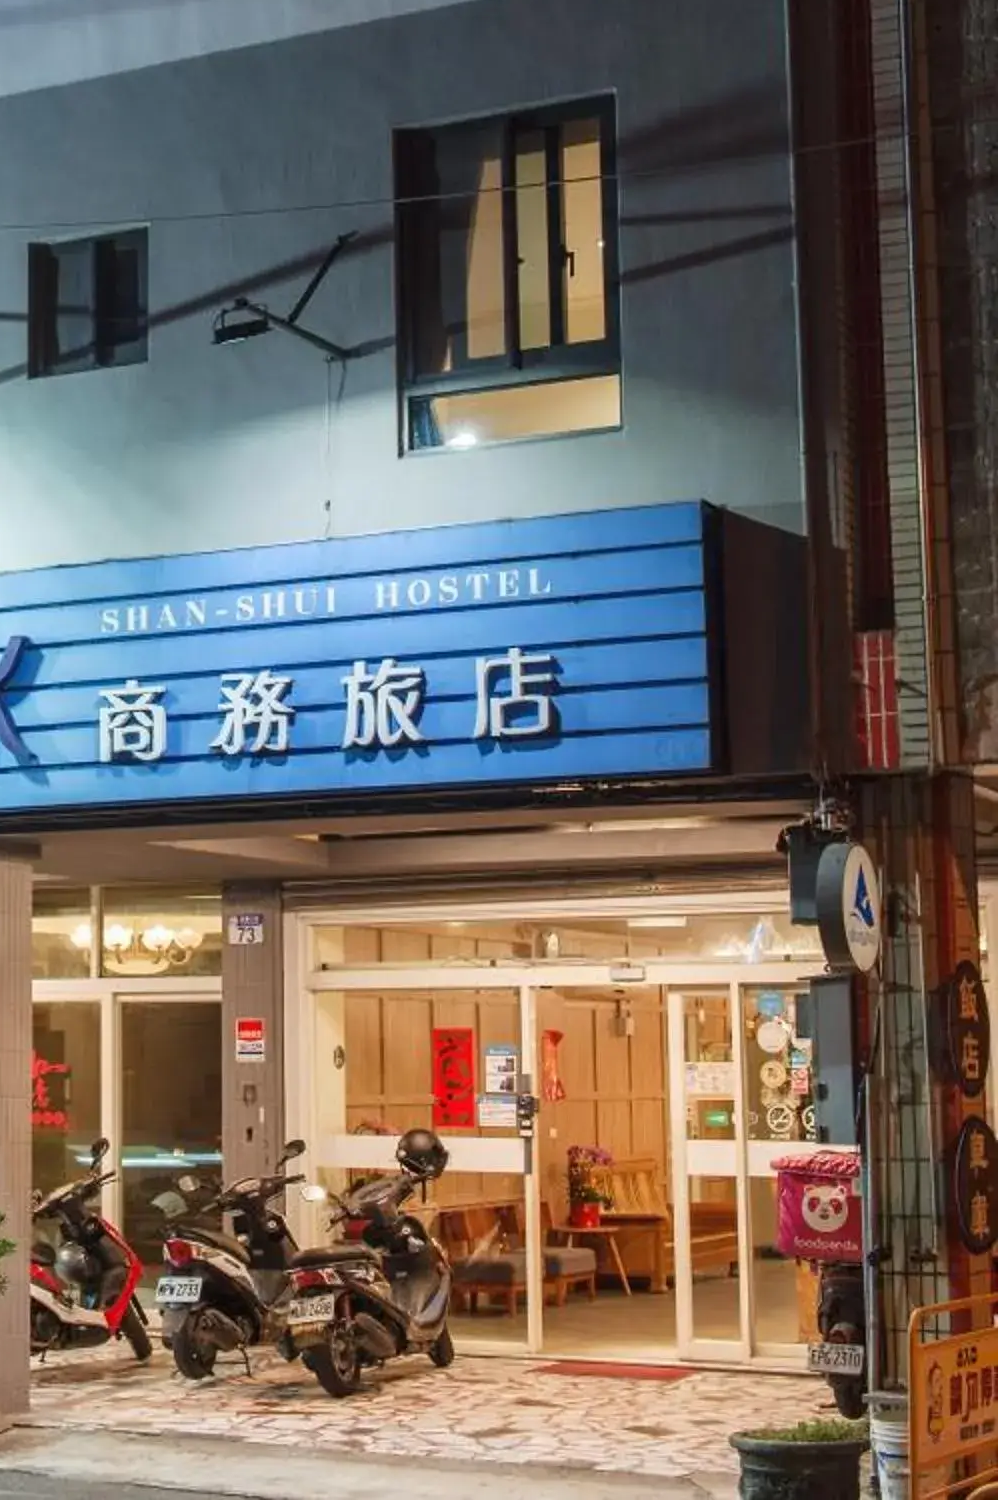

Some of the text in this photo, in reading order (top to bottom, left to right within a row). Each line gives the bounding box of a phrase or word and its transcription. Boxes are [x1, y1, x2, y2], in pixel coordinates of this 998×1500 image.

[101, 567, 553, 634] SHAN-SHUI HOSTEL
[99, 647, 558, 764] 商務旅店
[238, 927, 255, 942] 73
[794, 1236, 859, 1252] foodpanda
